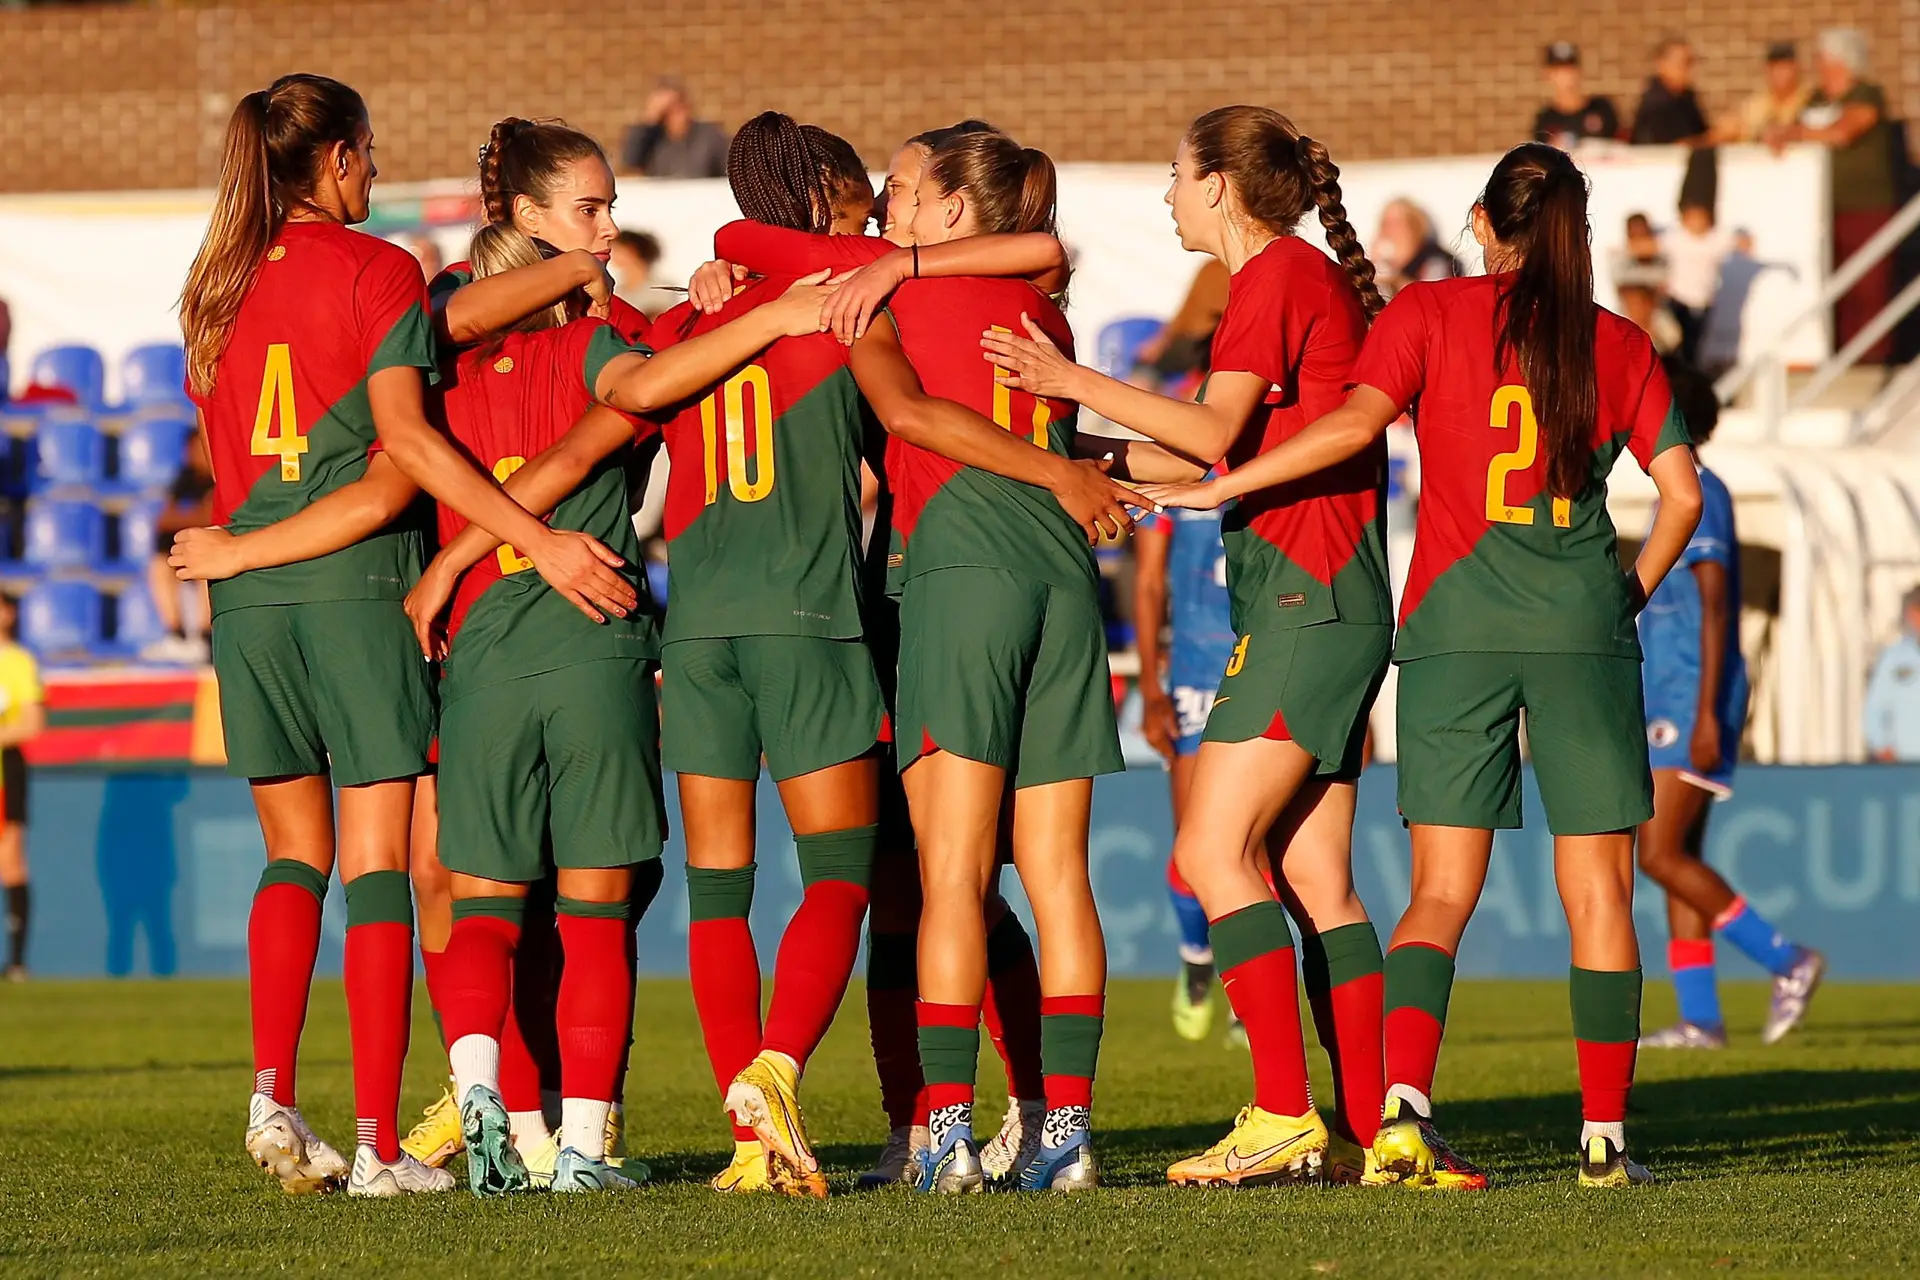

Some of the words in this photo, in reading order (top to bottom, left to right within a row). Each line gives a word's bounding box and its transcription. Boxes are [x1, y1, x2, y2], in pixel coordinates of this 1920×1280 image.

[250, 343, 308, 481] 4
[700, 364, 775, 506] 10
[1486, 385, 1570, 527] 2
